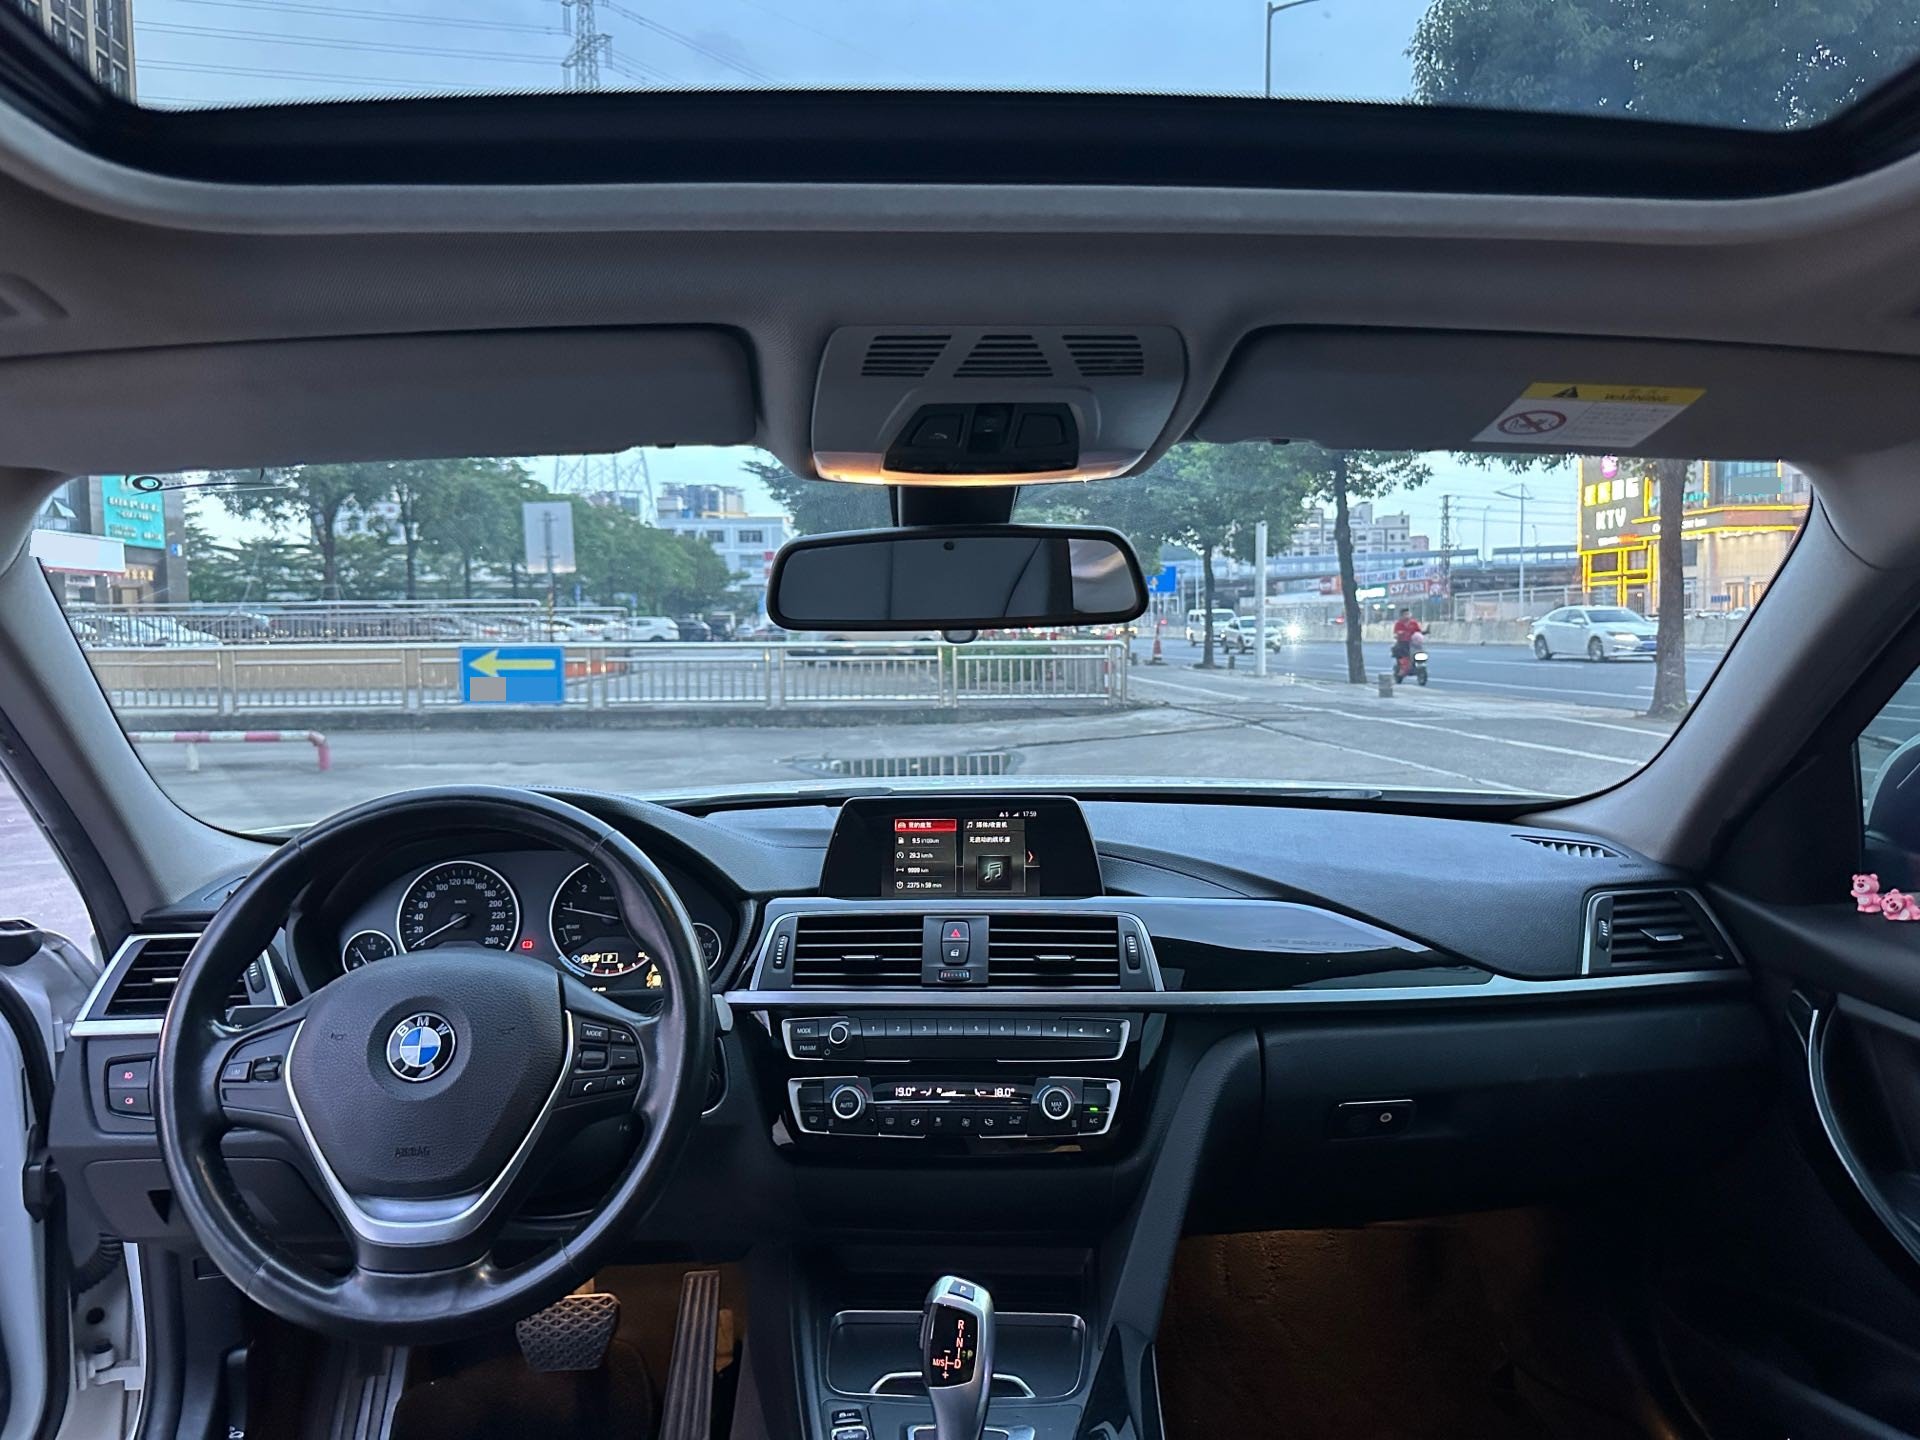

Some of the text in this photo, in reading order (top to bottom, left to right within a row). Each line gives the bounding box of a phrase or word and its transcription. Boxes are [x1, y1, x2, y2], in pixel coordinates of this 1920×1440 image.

[1595, 507, 1627, 530] KTV
[436, 883, 448, 891] 100
[475, 882, 487, 890] 160
[426, 891, 436, 899] 80
[484, 889, 496, 897] 180
[418, 901, 429, 909] 60
[489, 900, 503, 908] 200
[414, 926, 424, 934] 20
[490, 924, 505, 932] 240
[485, 937, 499, 945] 260
[396, 1015, 450, 1038] BMW
[839, 1101, 853, 1109] AUTO
[957, 1319, 965, 1330] R
[956, 1337, 964, 1348] N
[932, 1358, 945, 1367] M/S
[954, 1358, 962, 1369] D
